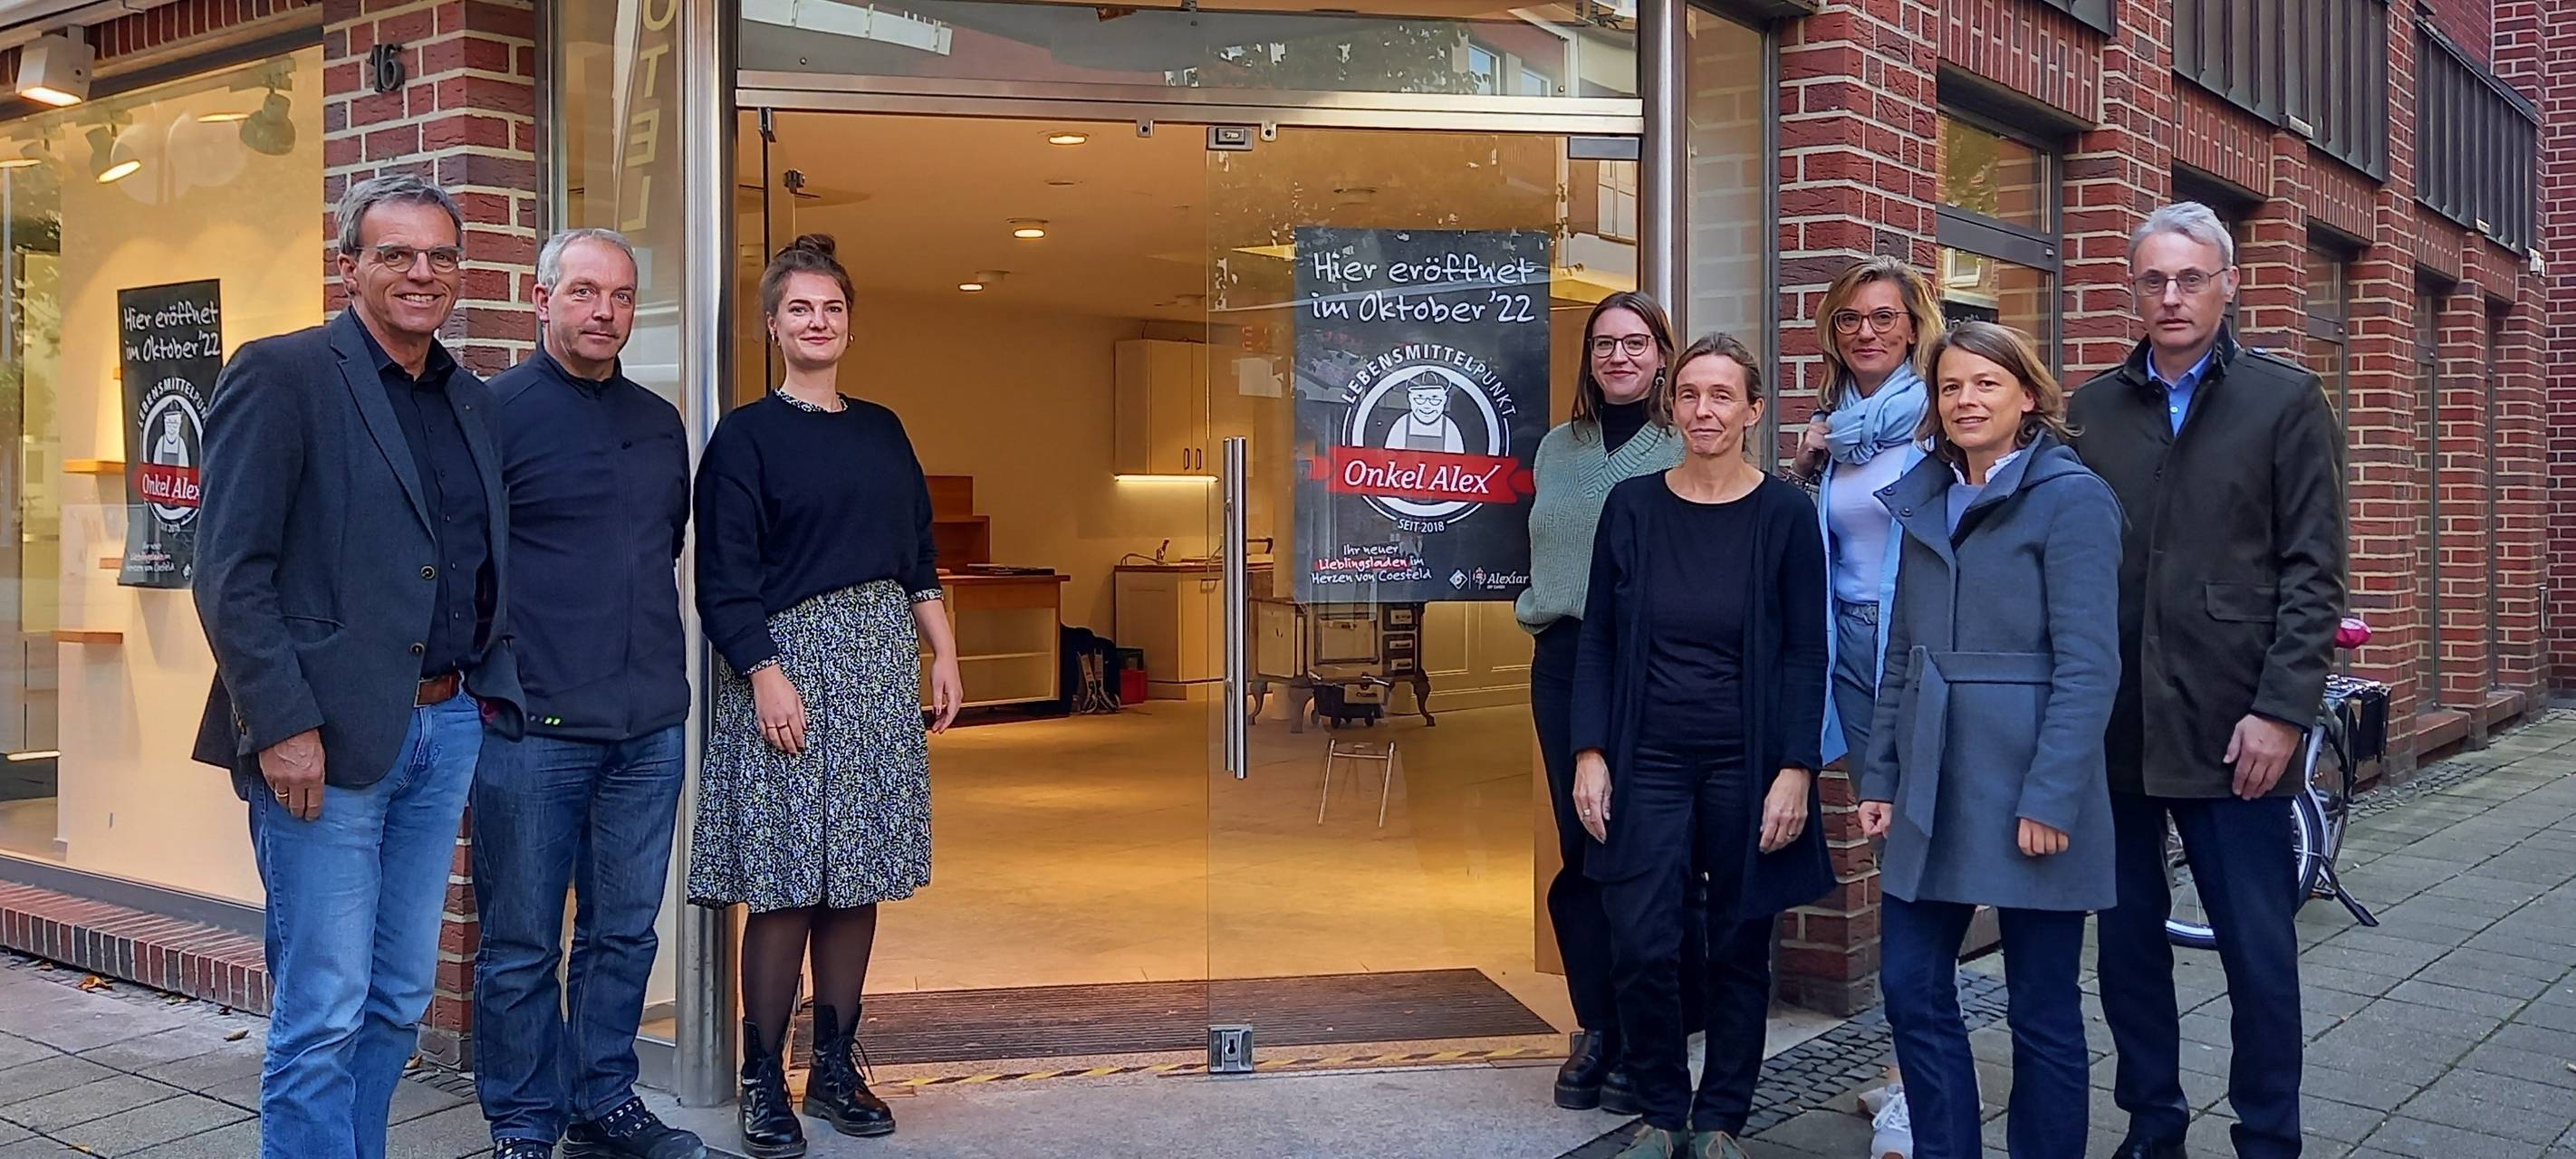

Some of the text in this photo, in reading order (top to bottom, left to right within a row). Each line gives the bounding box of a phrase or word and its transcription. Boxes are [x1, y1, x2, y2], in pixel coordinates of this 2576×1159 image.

[366, 43, 406, 92] 16
[1313, 252, 1535, 284] Hier eröffnet
[123, 300, 219, 332] Hier eröffnet
[1311, 292, 1350, 320] im
[1359, 290, 1486, 322] Oktober
[125, 340, 140, 361] im
[143, 334, 199, 362] Oktober
[1341, 344, 1517, 417] LEBENSMITTELPUNKT
[141, 474, 170, 498] Onkel
[1344, 460, 1502, 494] Onkel Alex
[1398, 519, 1445, 533] SEIT 2018
[1318, 555, 1425, 572] Lieblingsladen im
[1343, 543, 1399, 555] Ihr neuer
[1311, 568, 1433, 585] Herzen von Coesfeld
